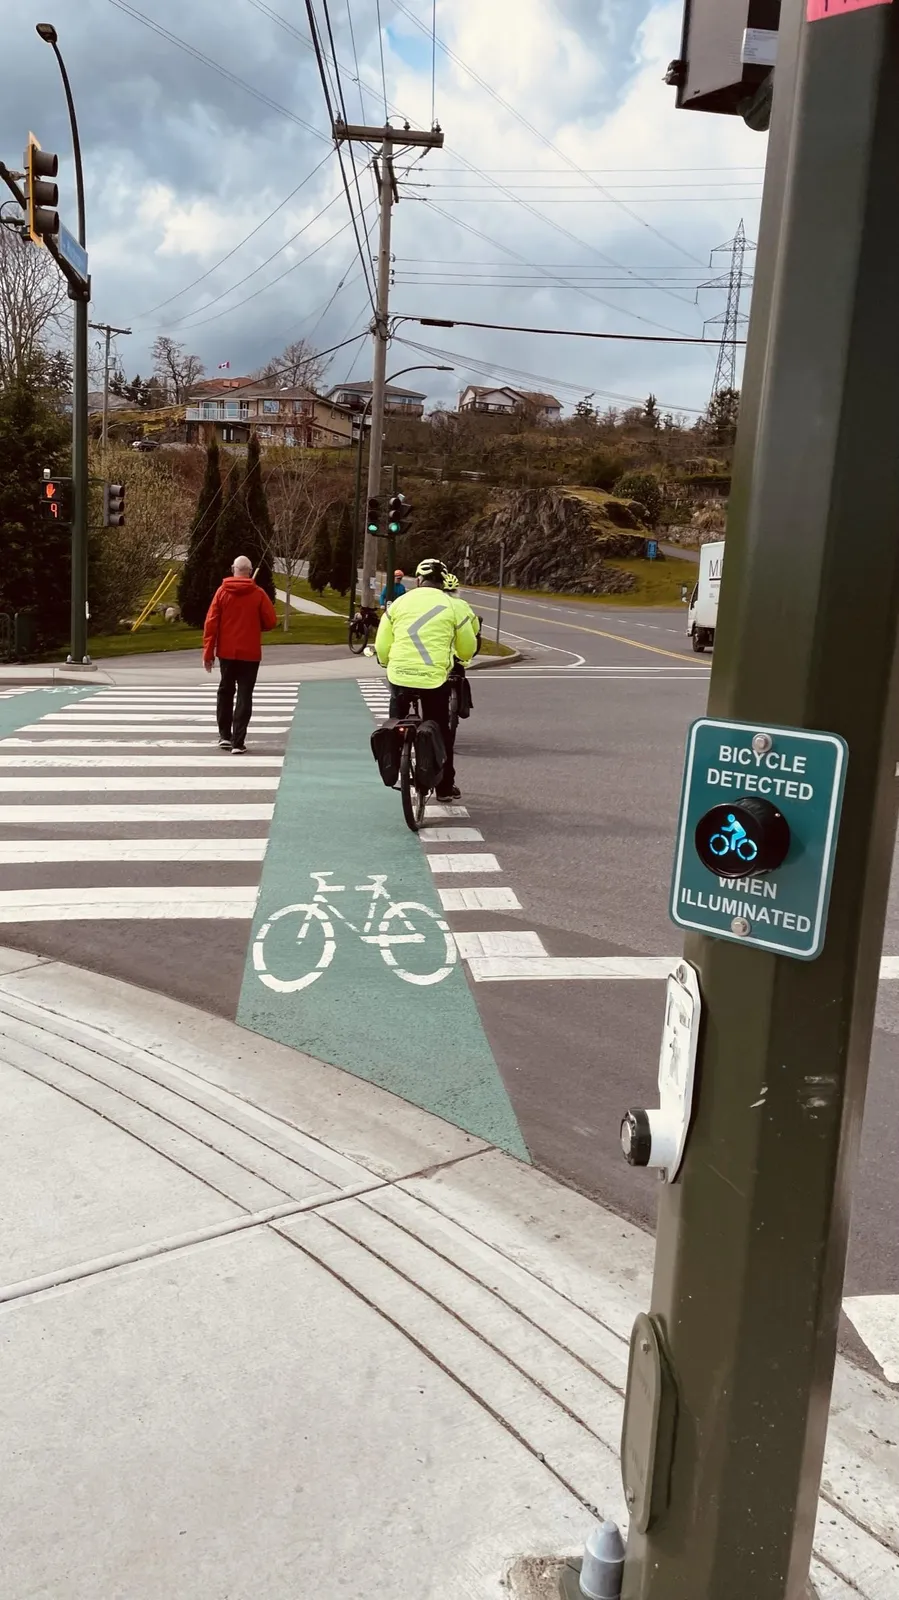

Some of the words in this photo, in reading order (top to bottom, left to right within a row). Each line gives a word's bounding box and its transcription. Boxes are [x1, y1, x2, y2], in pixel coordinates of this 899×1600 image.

[50, 503, 58, 518] 9
[718, 745, 807, 774] BICYCLE
[707, 768, 813, 801] DETECTED
[719, 876, 777, 900] WHEN
[681, 888, 811, 934] ILLUMINATED
